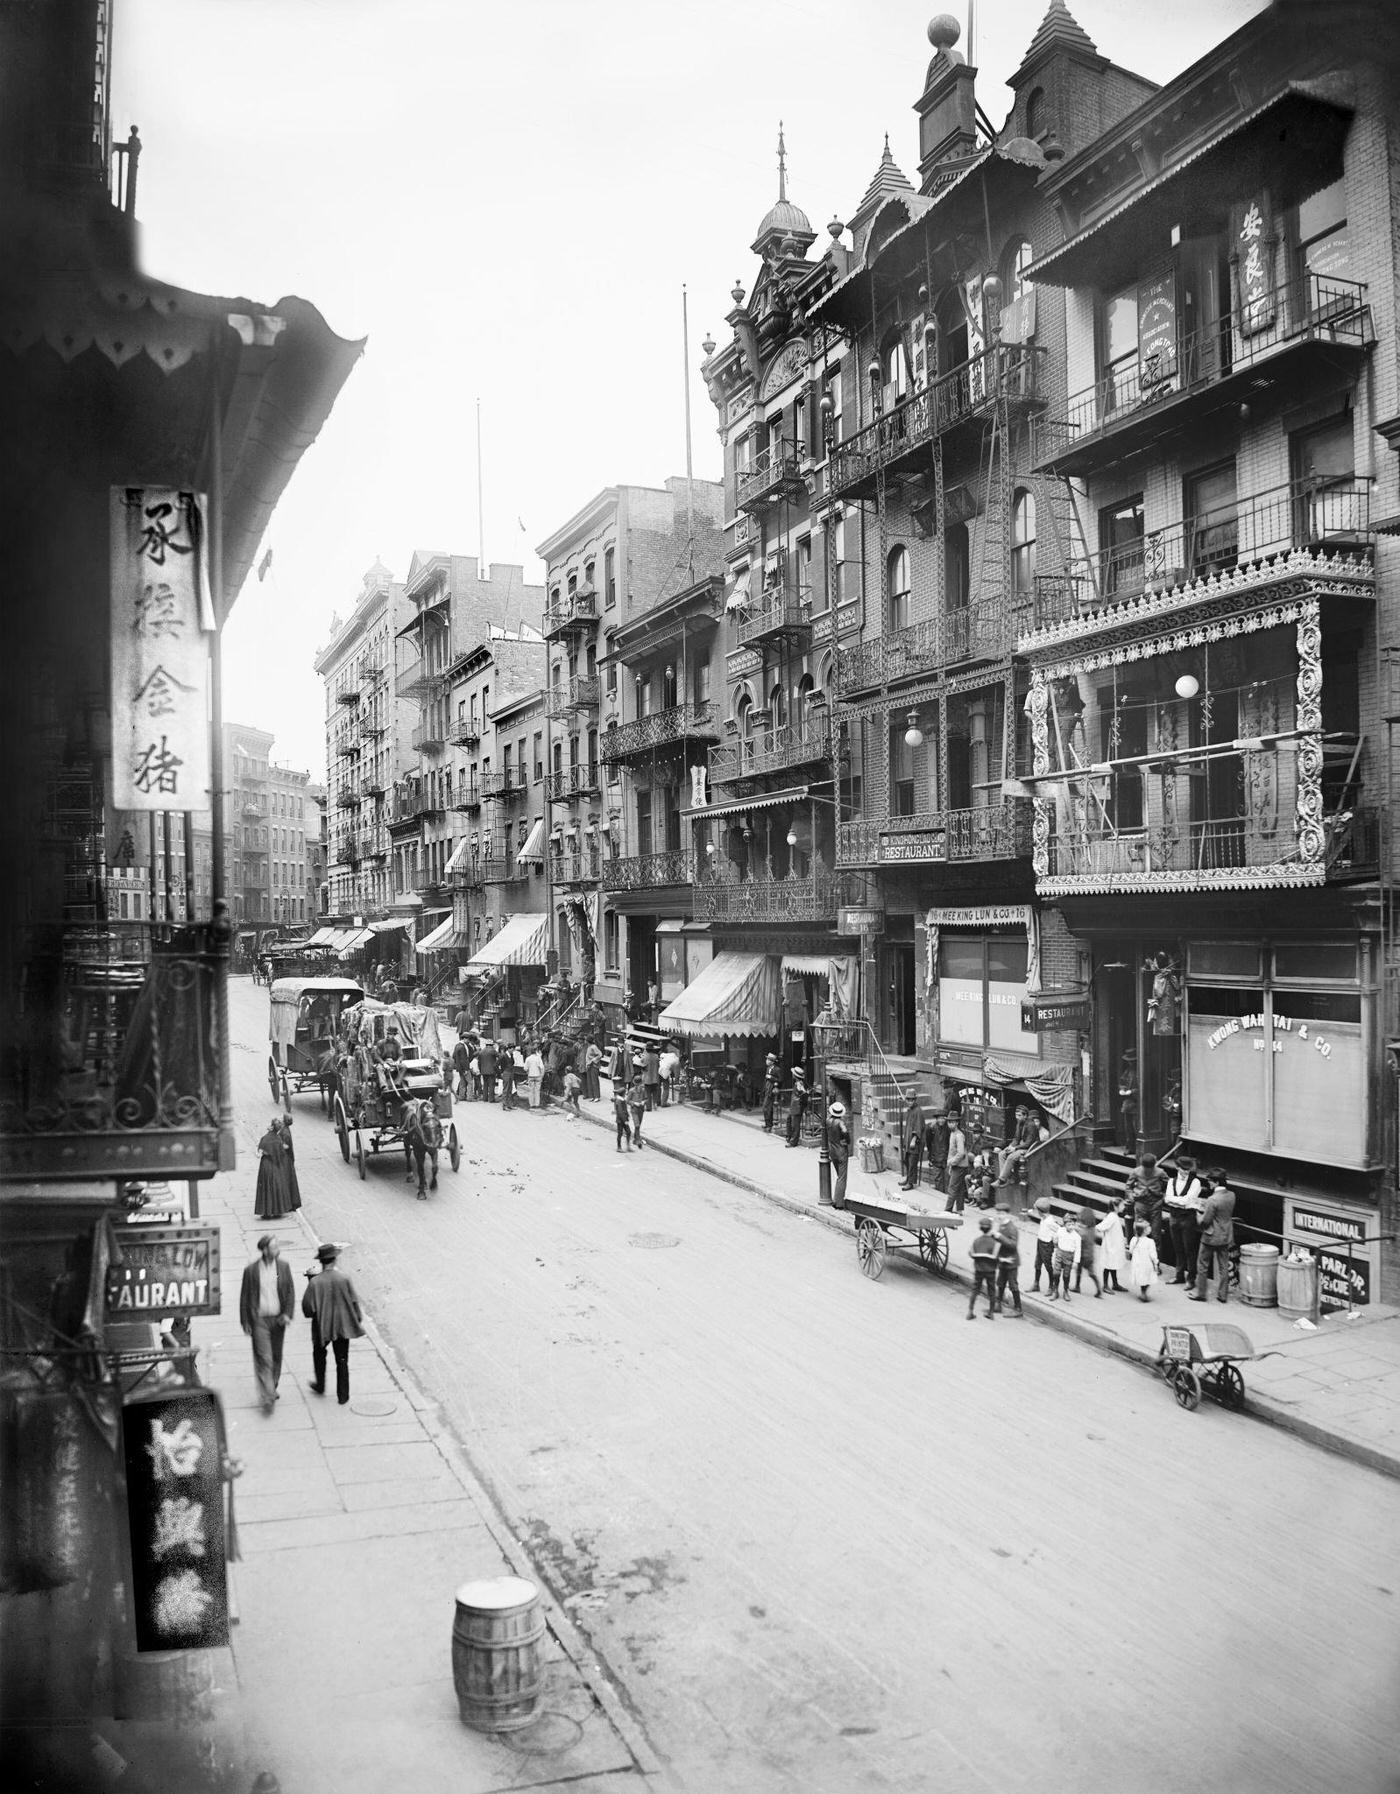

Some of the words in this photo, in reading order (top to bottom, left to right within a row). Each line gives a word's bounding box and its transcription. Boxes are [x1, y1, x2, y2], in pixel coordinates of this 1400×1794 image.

[943, 911, 956, 921] MEE
[956, 910, 973, 921] KING
[975, 909, 991, 921] LUN
[993, 910, 999, 919] &
[1016, 907, 1026, 918] 16
[1023, 1014, 1031, 1024] 14
[1207, 1019, 1240, 1050] KWONG
[1240, 1013, 1266, 1029] WAH
[1272, 1014, 1293, 1031] TAI
[1298, 1024, 1308, 1039] &
